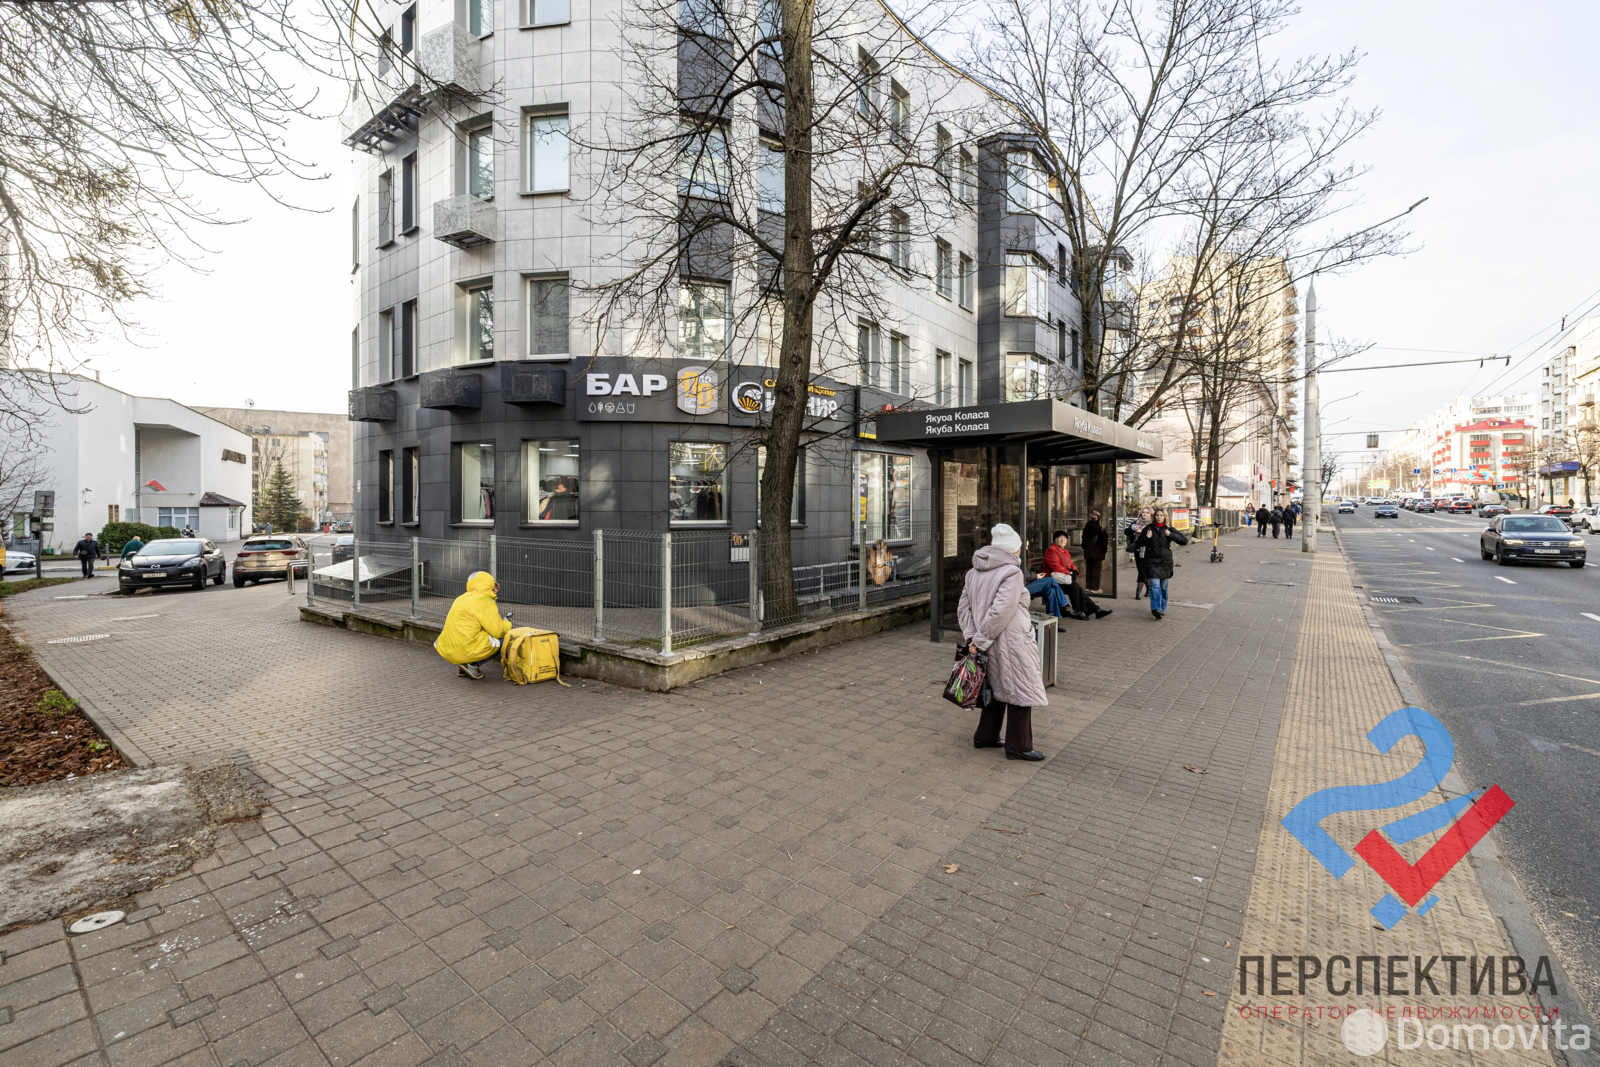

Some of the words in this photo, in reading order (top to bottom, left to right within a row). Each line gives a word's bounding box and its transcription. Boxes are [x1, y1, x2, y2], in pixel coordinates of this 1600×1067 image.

[586, 373, 668, 396] БАР
[954, 411, 990, 420] Коласа
[925, 424, 953, 435] Якуба
[954, 423, 990, 432] Коласа
